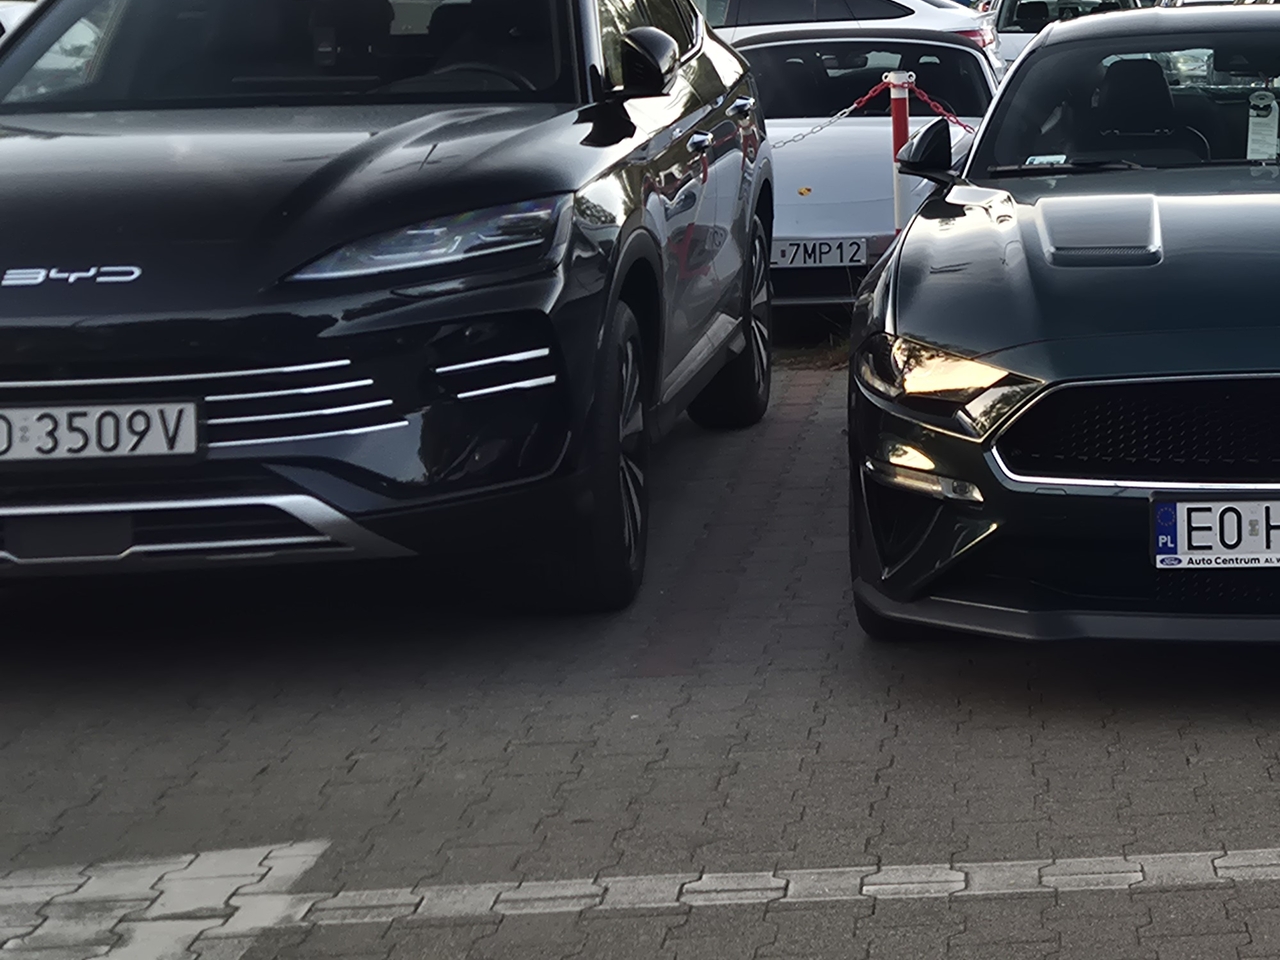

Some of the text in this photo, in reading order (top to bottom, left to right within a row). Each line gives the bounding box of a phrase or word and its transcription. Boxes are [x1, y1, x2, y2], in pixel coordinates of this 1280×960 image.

[788, 242, 861, 264] 7MP12
[1, 266, 142, 286] BYD
[35, 409, 184, 454] 3509V
[1158, 535, 1175, 547] PL
[1187, 556, 1260, 565] Auto Centrum
